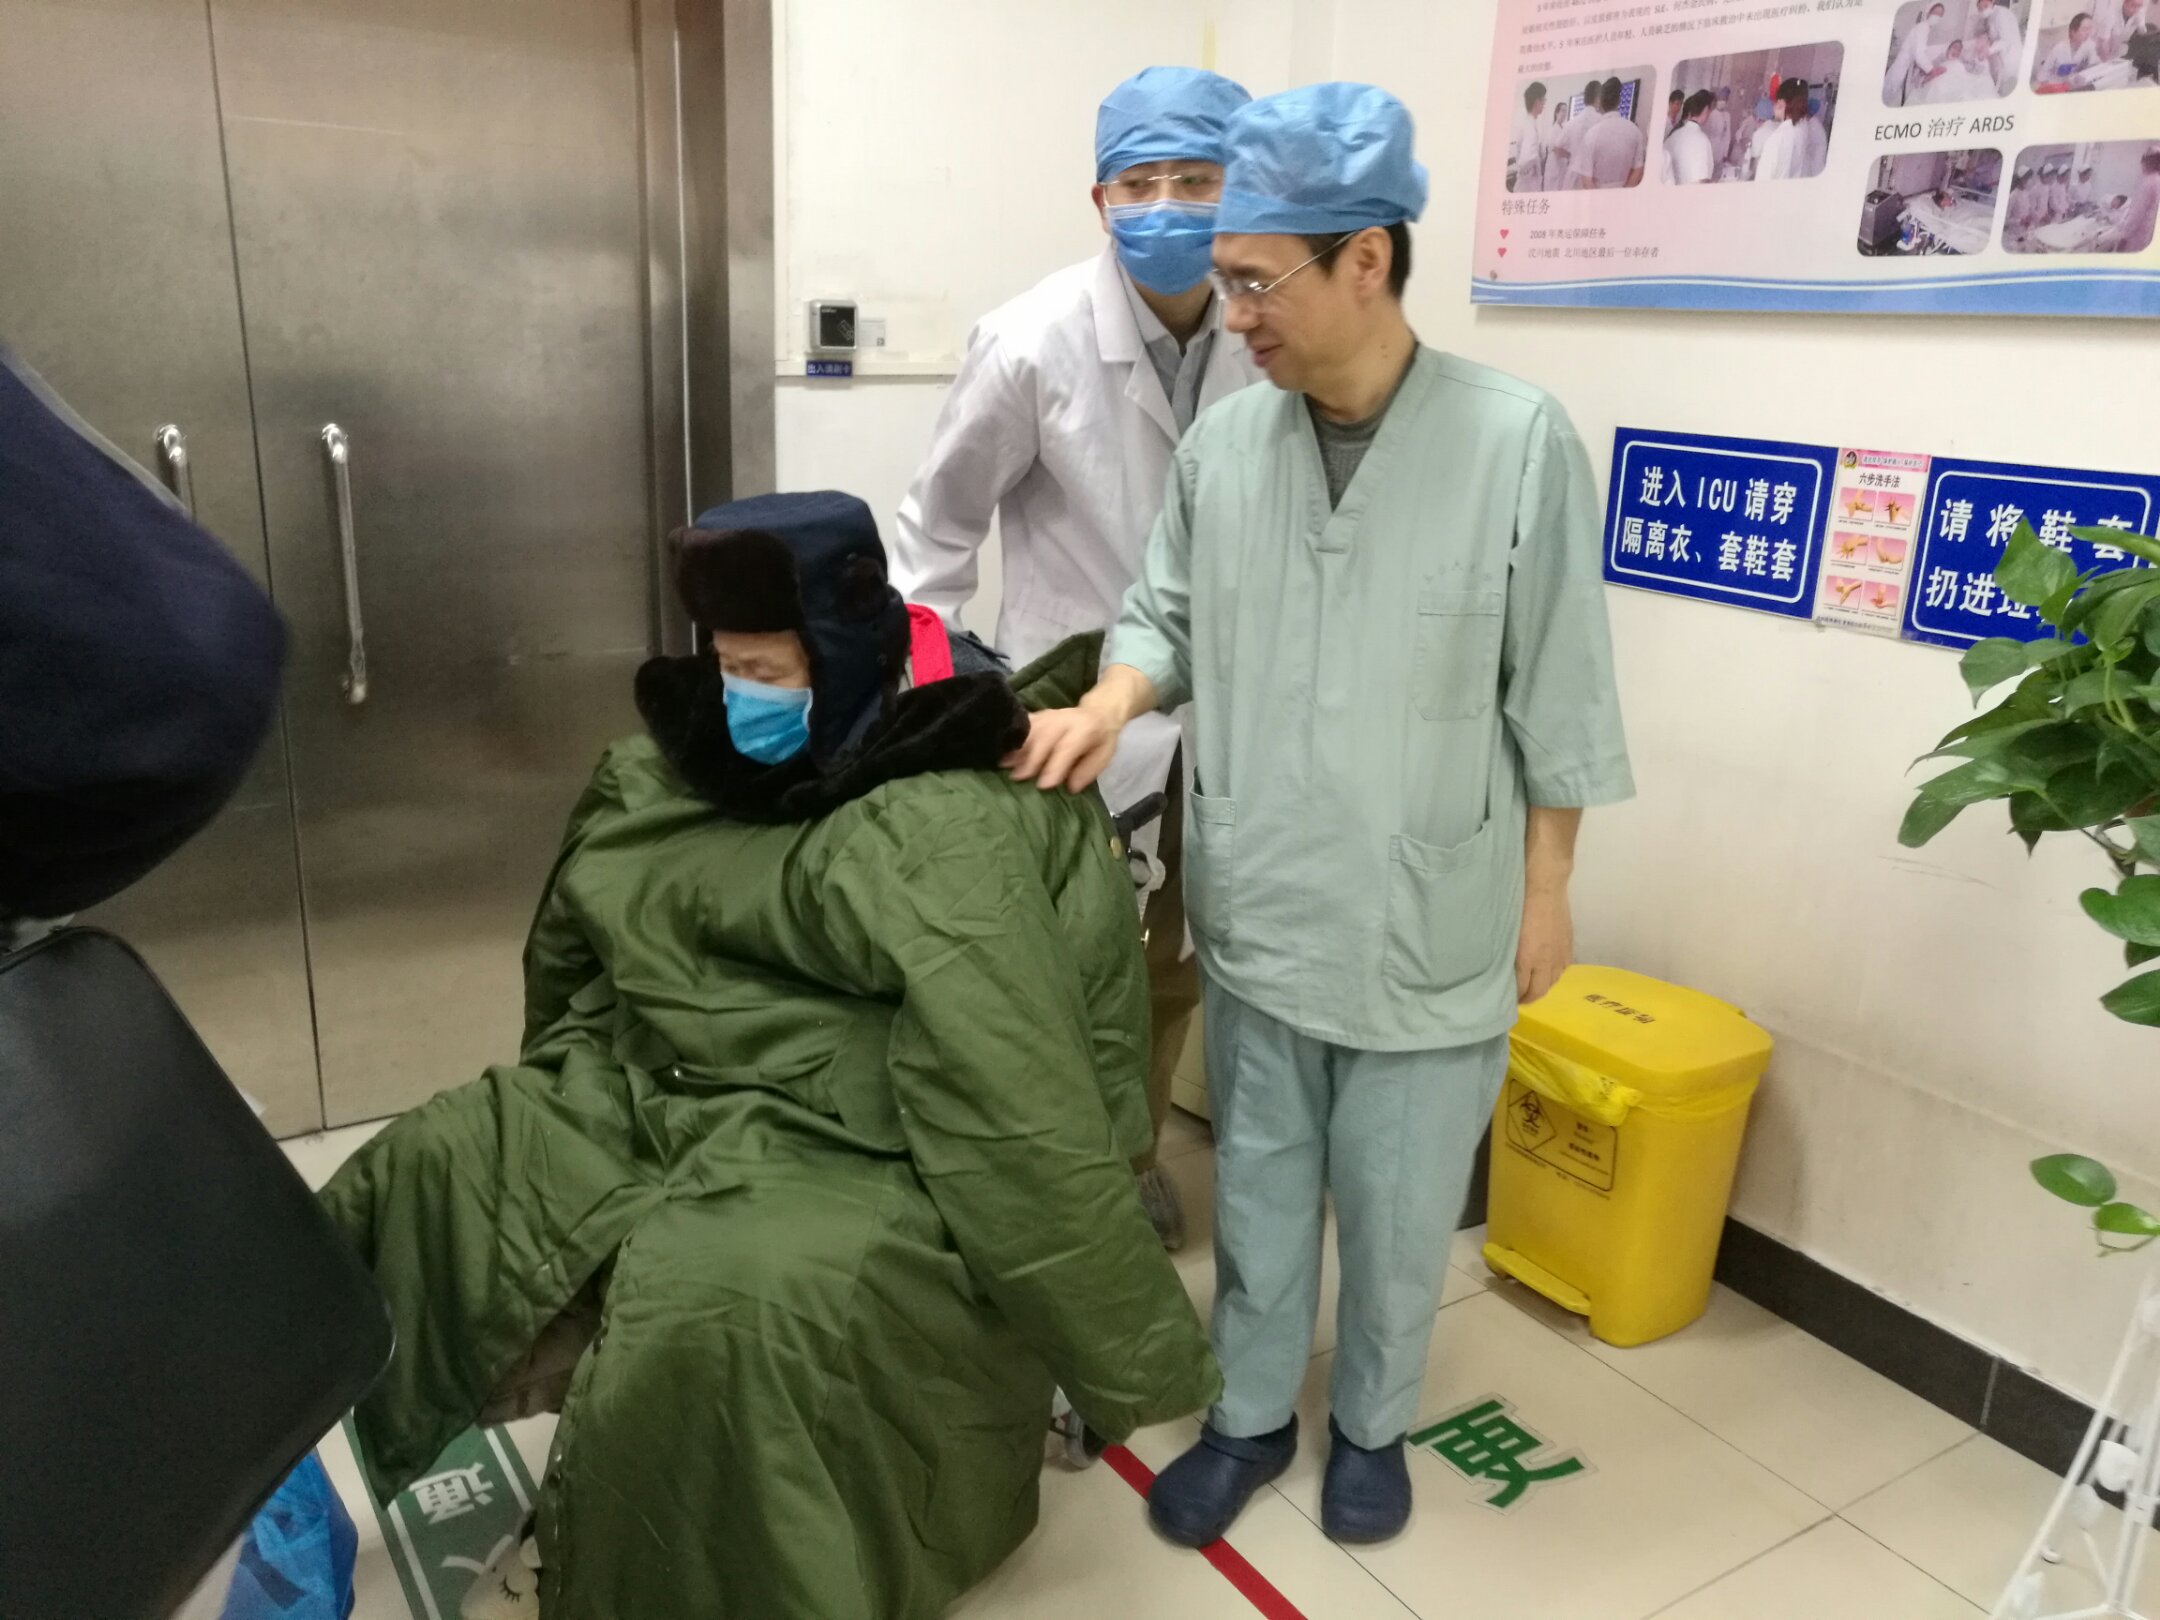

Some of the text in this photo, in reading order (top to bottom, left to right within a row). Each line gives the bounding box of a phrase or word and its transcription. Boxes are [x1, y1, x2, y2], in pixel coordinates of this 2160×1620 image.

[1874, 115, 2015, 141] ECMO 治疗 ARDS
[1501, 198, 1551, 216] 特殊任务
[1858, 472, 1902, 488] 六步洗手法
[1639, 465, 1798, 526] 进入 ICU 请穿
